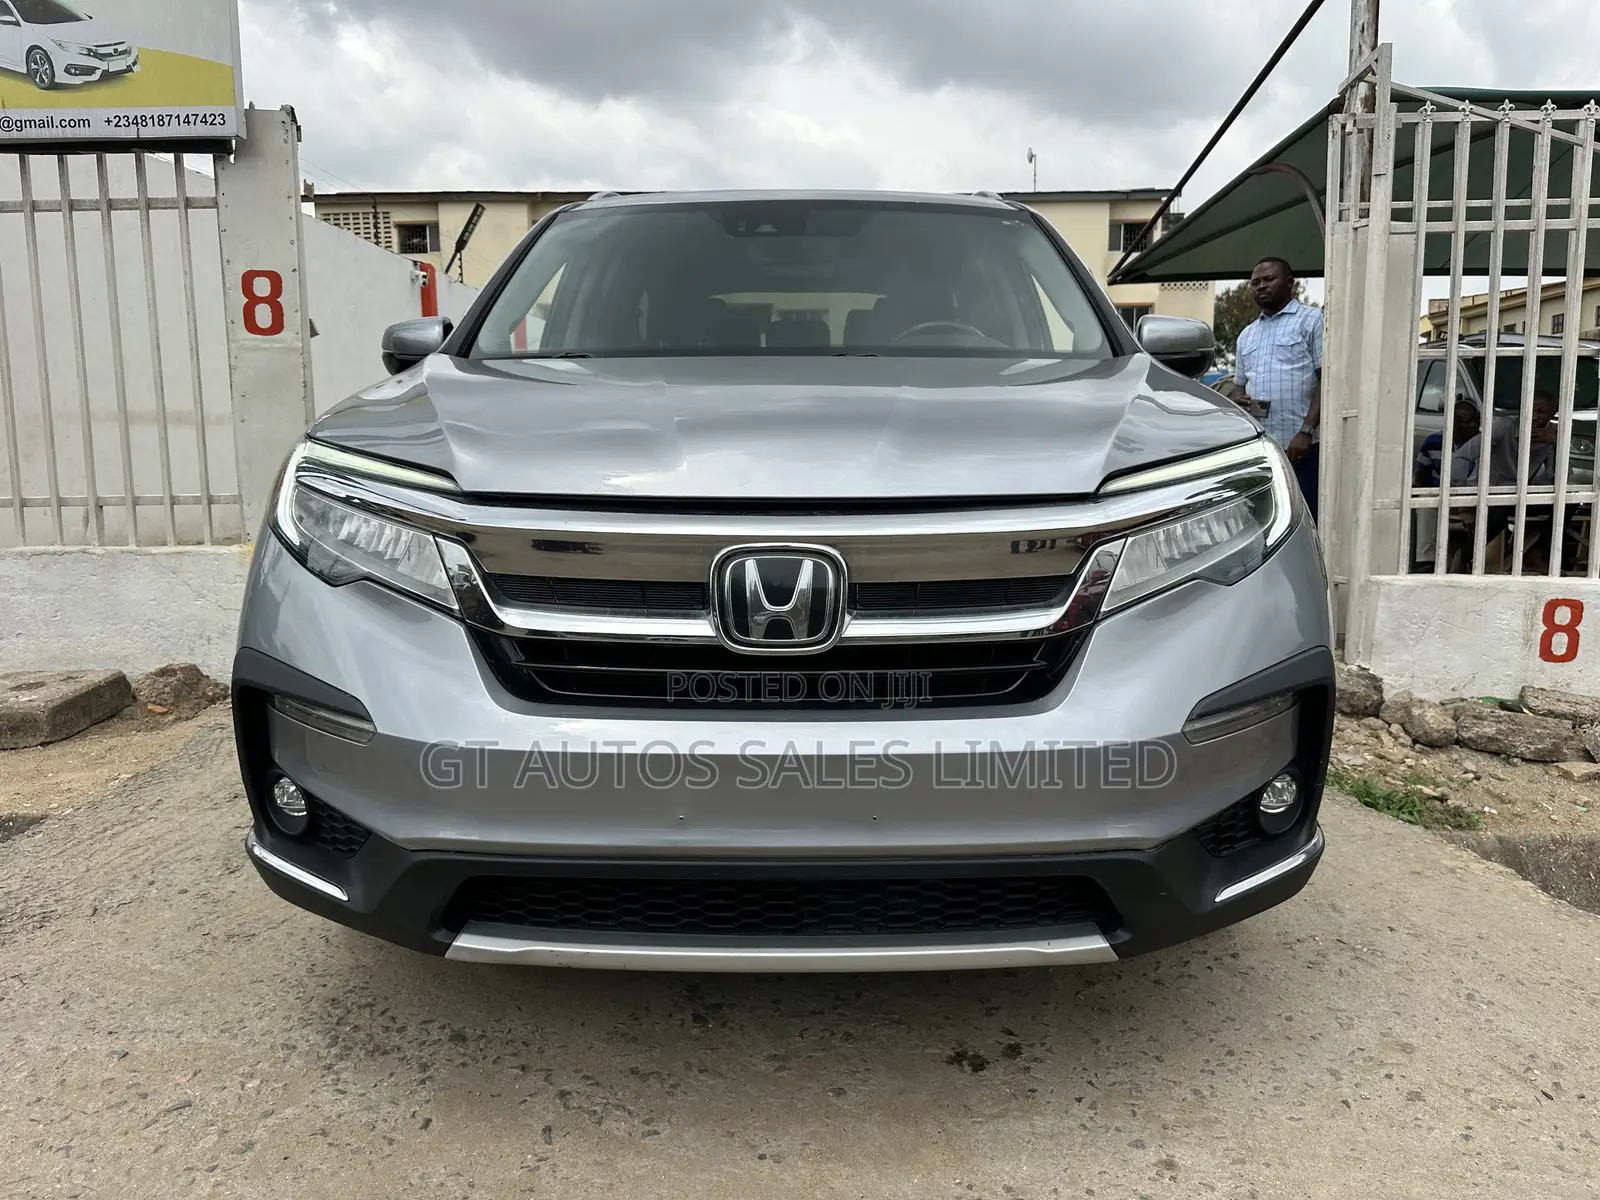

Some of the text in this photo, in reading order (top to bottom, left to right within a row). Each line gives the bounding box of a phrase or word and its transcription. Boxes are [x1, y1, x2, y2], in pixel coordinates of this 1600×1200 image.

[104, 113, 226, 128] +2348187147423
[241, 269, 285, 336] 8
[1538, 597, 1585, 663] 8
